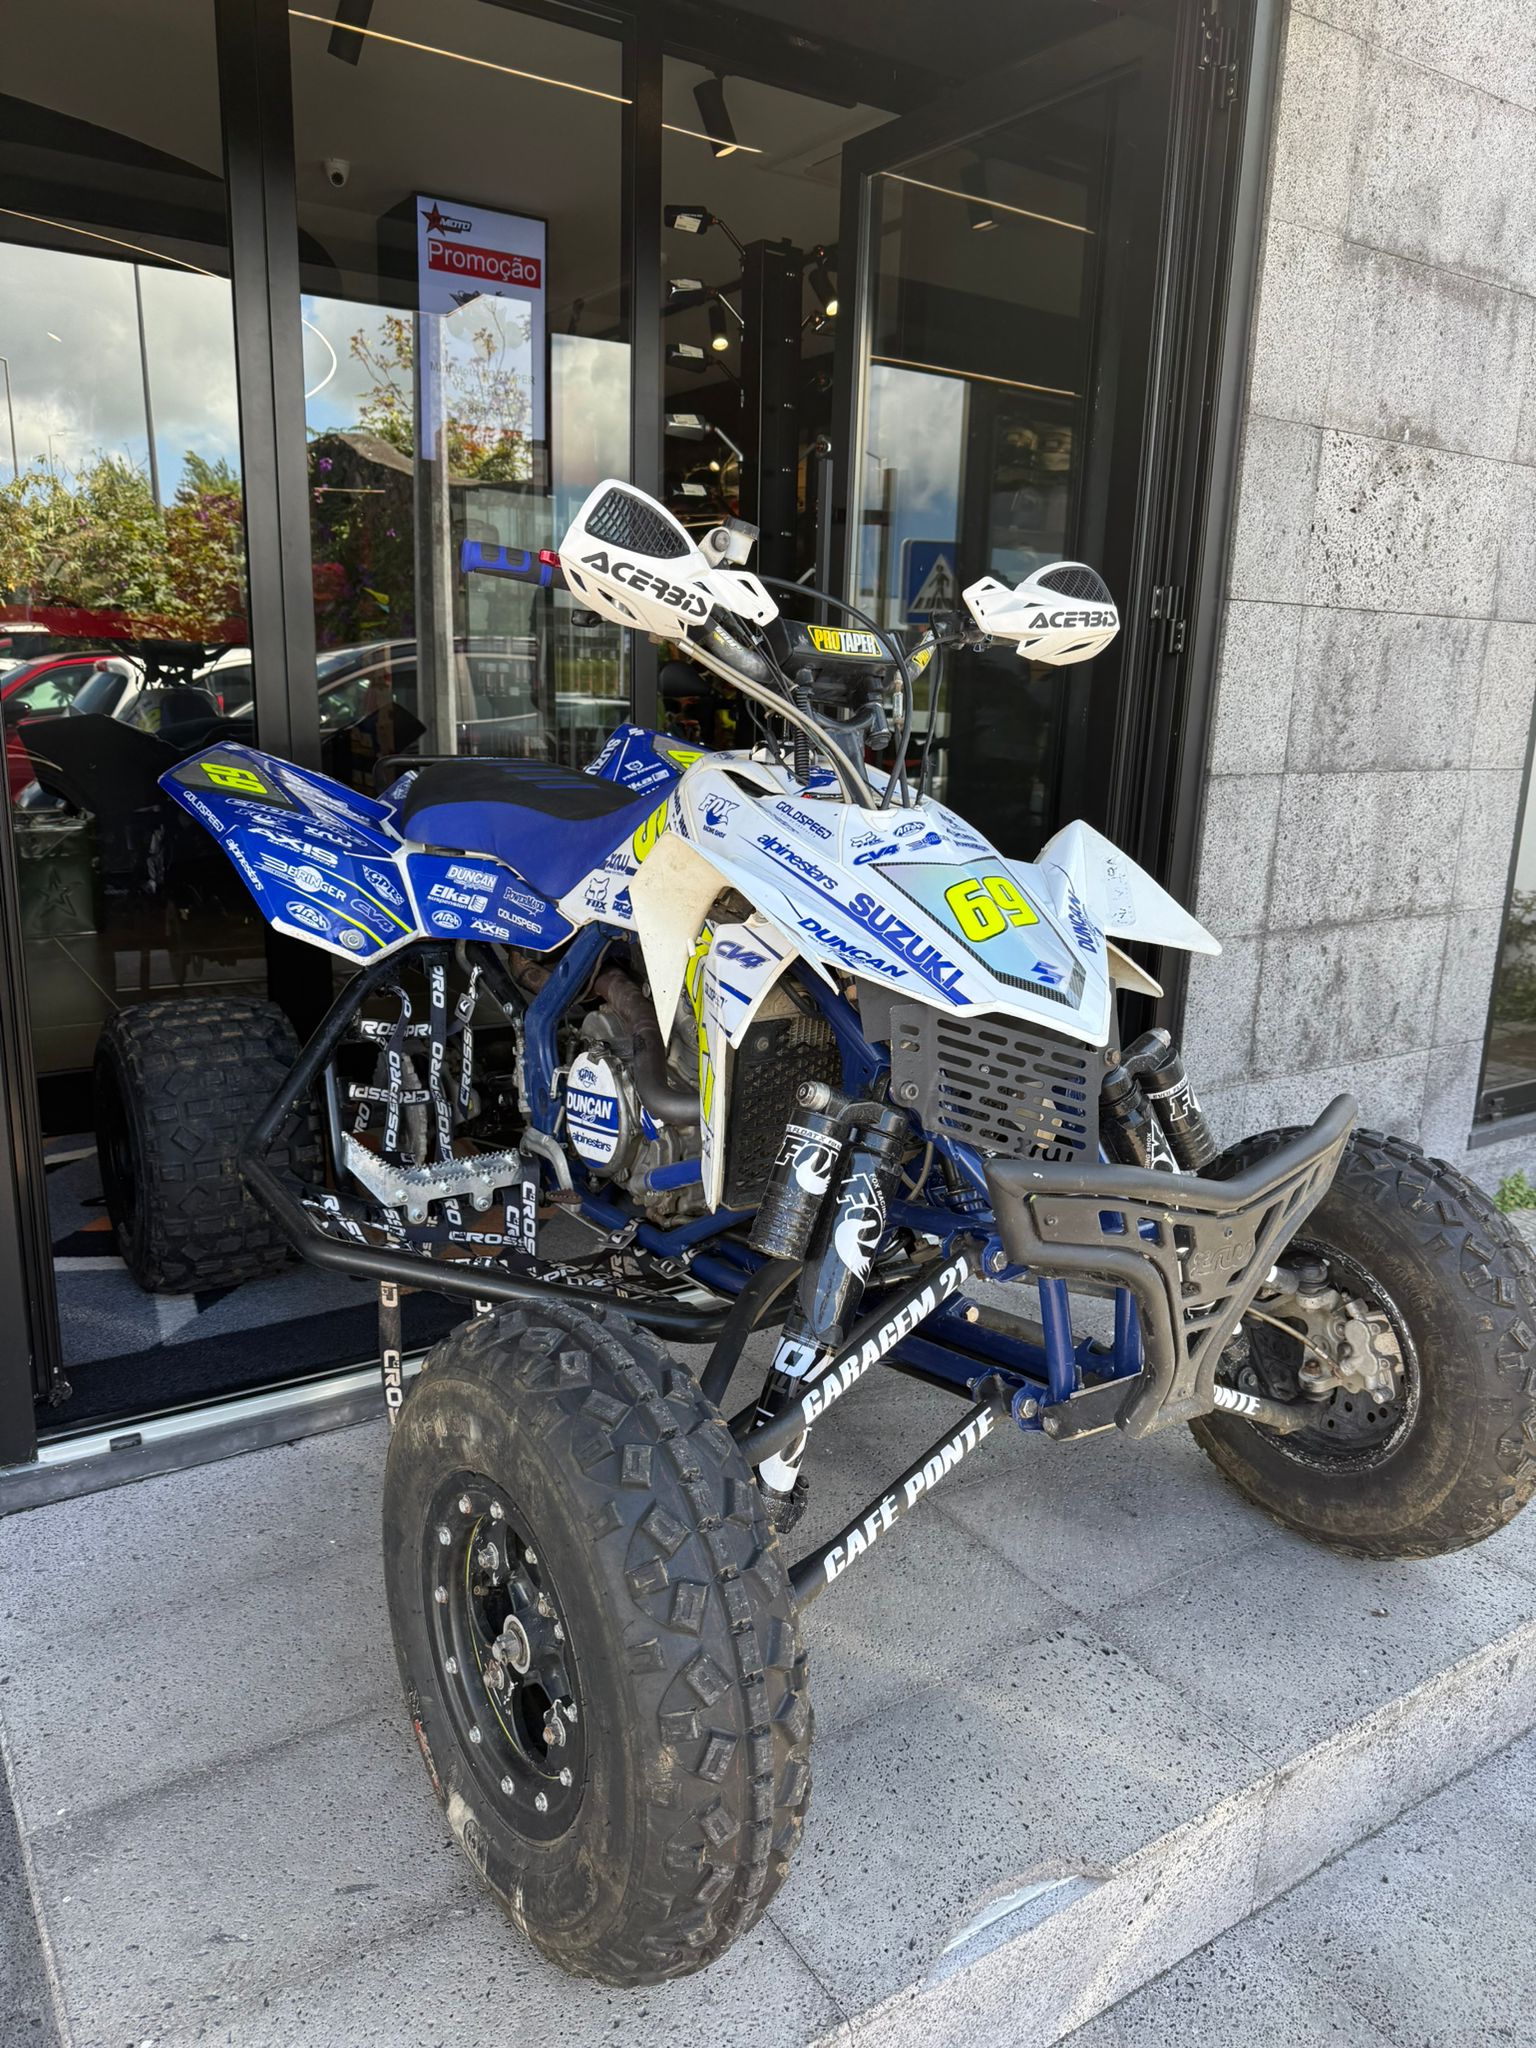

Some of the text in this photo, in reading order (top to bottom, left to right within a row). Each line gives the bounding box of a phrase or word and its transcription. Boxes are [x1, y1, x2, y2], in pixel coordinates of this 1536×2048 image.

[429, 240, 537, 281] Promoção
[814, 628, 877, 655] PROTAPER
[183, 790, 225, 833] GOLDSPEED
[775, 801, 833, 840] GOLDSPEED
[225, 839, 265, 892] alpinestars
[247, 827, 339, 865] AXIS
[757, 833, 839, 891] alpinestars
[259, 852, 347, 902] BERINGER
[430, 883, 471, 905] Elka
[447, 866, 497, 888] DUNCAN
[470, 919, 510, 938] AXIS
[497, 907, 543, 935] GOLDSPEED
[944, 876, 1040, 943] 69
[1068, 889, 1098, 954] DUNCAN
[797, 917, 909, 978] DUNCAN
[848, 893, 964, 990] SUZUKI
[567, 1091, 613, 1120] DUNCAN
[572, 1131, 612, 1152] alpinestars
[801, 1286, 936, 1425] GARAGEM
[940, 1256, 969, 1301] 21
[823, 1407, 994, 1583] CAFÉ PONTE
